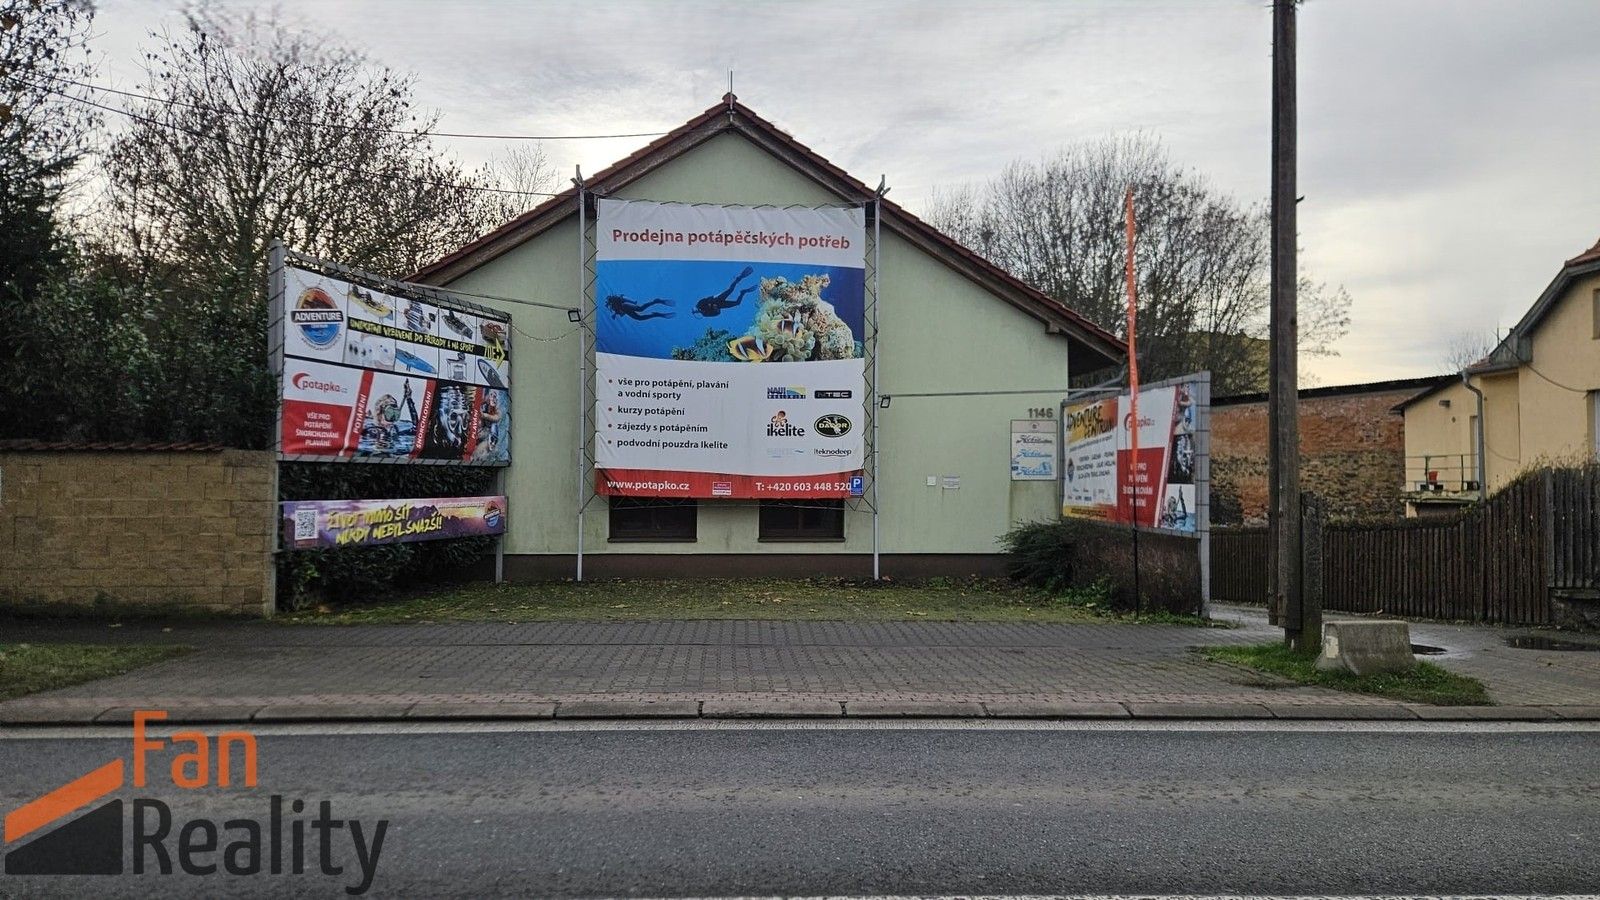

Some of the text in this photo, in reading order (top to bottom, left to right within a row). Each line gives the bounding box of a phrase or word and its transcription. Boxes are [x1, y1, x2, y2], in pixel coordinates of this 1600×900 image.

[612, 229, 850, 249] Prodejna potápěčských potřeb
[294, 312, 342, 321] ADVENTURE
[617, 378, 729, 389] vše pro potápění, plavání
[625, 390, 651, 398] vodní
[652, 392, 681, 400] sporty
[617, 406, 685, 417] kurzy potápění
[1028, 408, 1053, 418] 1146
[617, 422, 651, 433] zájezdy
[659, 424, 708, 433] potápěním
[767, 423, 805, 437] ikelite
[617, 439, 728, 450] podvodní pouzdra Ikelite
[607, 481, 690, 492] www.potapko.cz
[755, 482, 765, 491] T:
[767, 482, 791, 491] +420
[793, 482, 811, 491] 603
[814, 482, 832, 491] 448
[834, 482, 851, 491] 520
